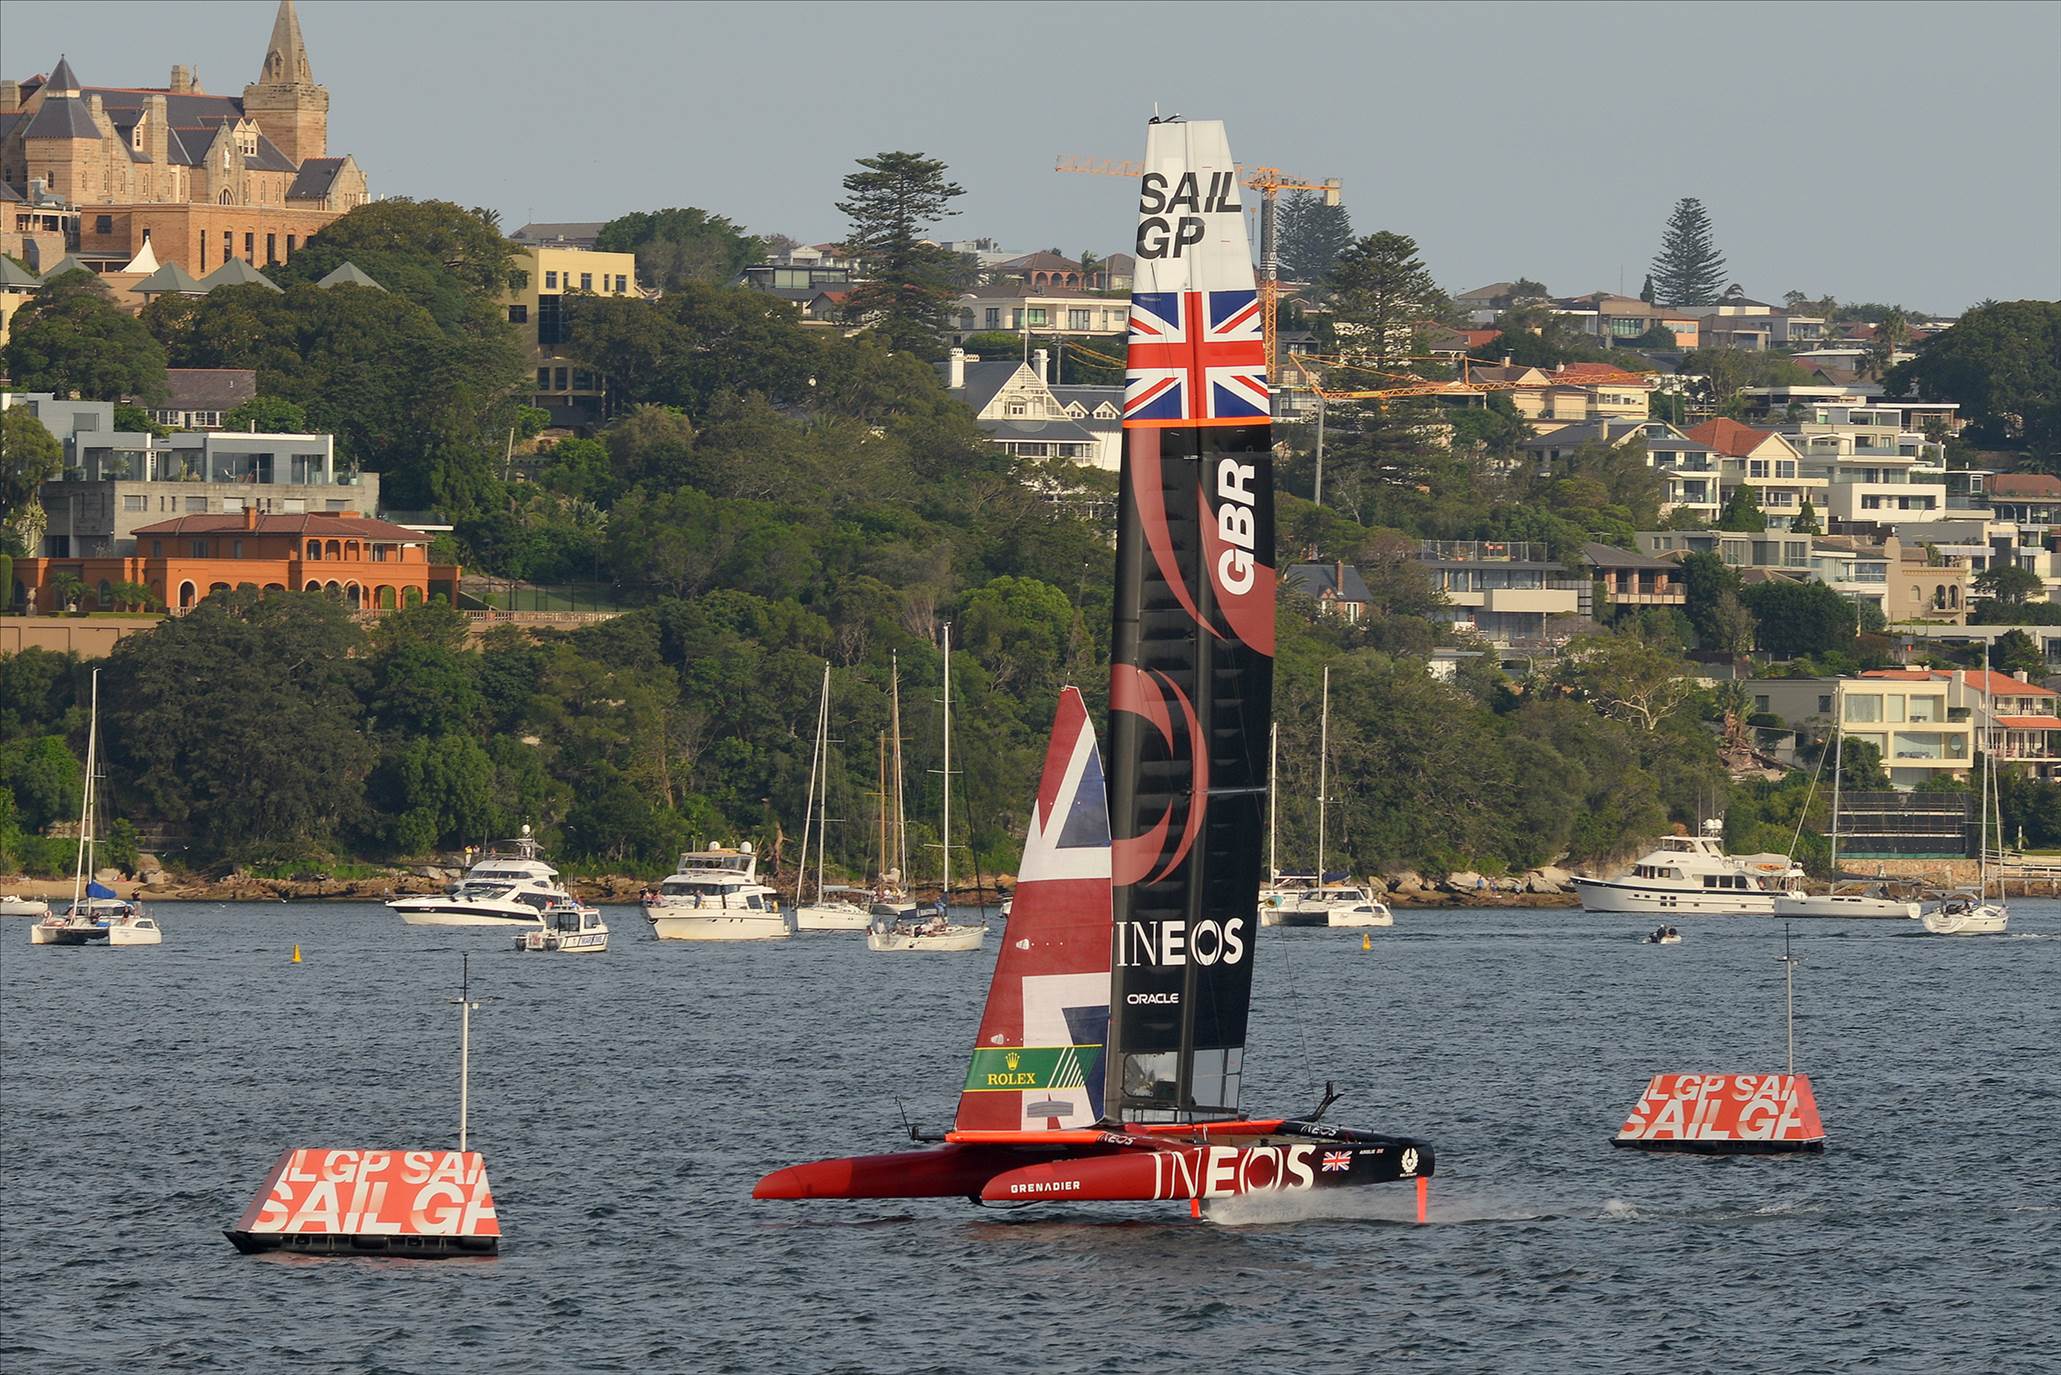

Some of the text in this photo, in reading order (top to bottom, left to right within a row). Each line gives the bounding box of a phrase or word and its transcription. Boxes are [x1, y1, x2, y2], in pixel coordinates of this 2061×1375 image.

[1139, 171, 1242, 214] SAIL
[1136, 216, 1205, 259] GP
[1218, 458, 1255, 596] GBR
[1116, 917, 1244, 967] INEOS
[1126, 993, 1180, 1005] ORACLE
[987, 1072, 1037, 1086] ROLEX
[1673, 1074, 1726, 1101] GP
[1731, 1075, 1798, 1101] SAI
[1616, 1099, 1730, 1140] SAIL
[322, 1150, 392, 1183] GP
[400, 1151, 487, 1185] SAI
[1010, 1180, 1081, 1194] GRENADIER
[1149, 1144, 1316, 1200] INEOS
[251, 1180, 402, 1234] SAIL
